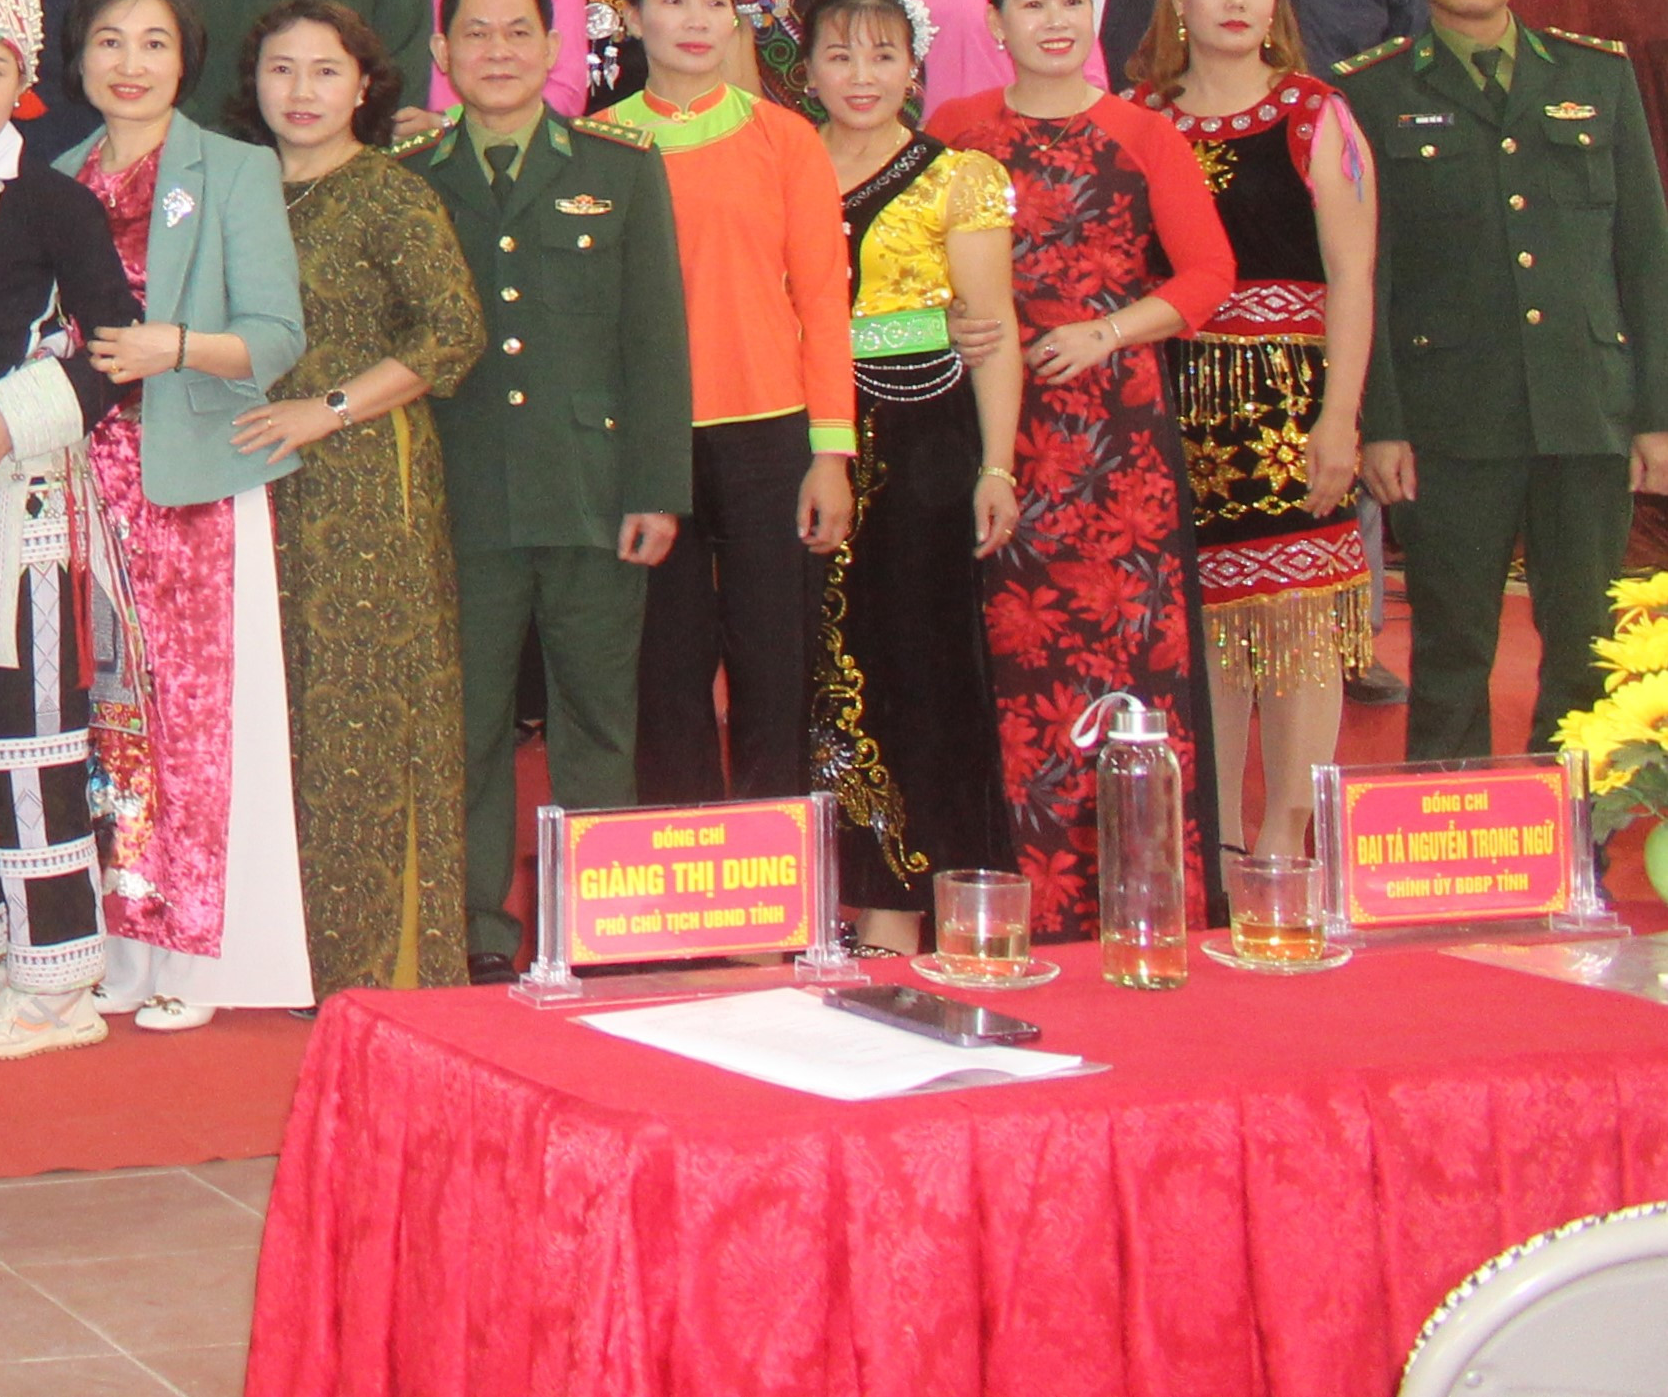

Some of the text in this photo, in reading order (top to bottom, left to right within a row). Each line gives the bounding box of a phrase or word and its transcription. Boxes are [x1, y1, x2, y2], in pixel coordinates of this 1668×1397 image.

[1357, 836, 1383, 870] ĐẠI
[1386, 828, 1405, 863] TÁ
[1471, 828, 1519, 863] TRỌNG
[580, 855, 798, 900] GIÀNG THỊ DUNG
[1386, 877, 1430, 898] CHÍNH
[1434, 874, 1452, 895] ỦY
[631, 910, 662, 932] CHỦ
[666, 914, 700, 934] TỊCH
[705, 909, 745, 928] UBND
